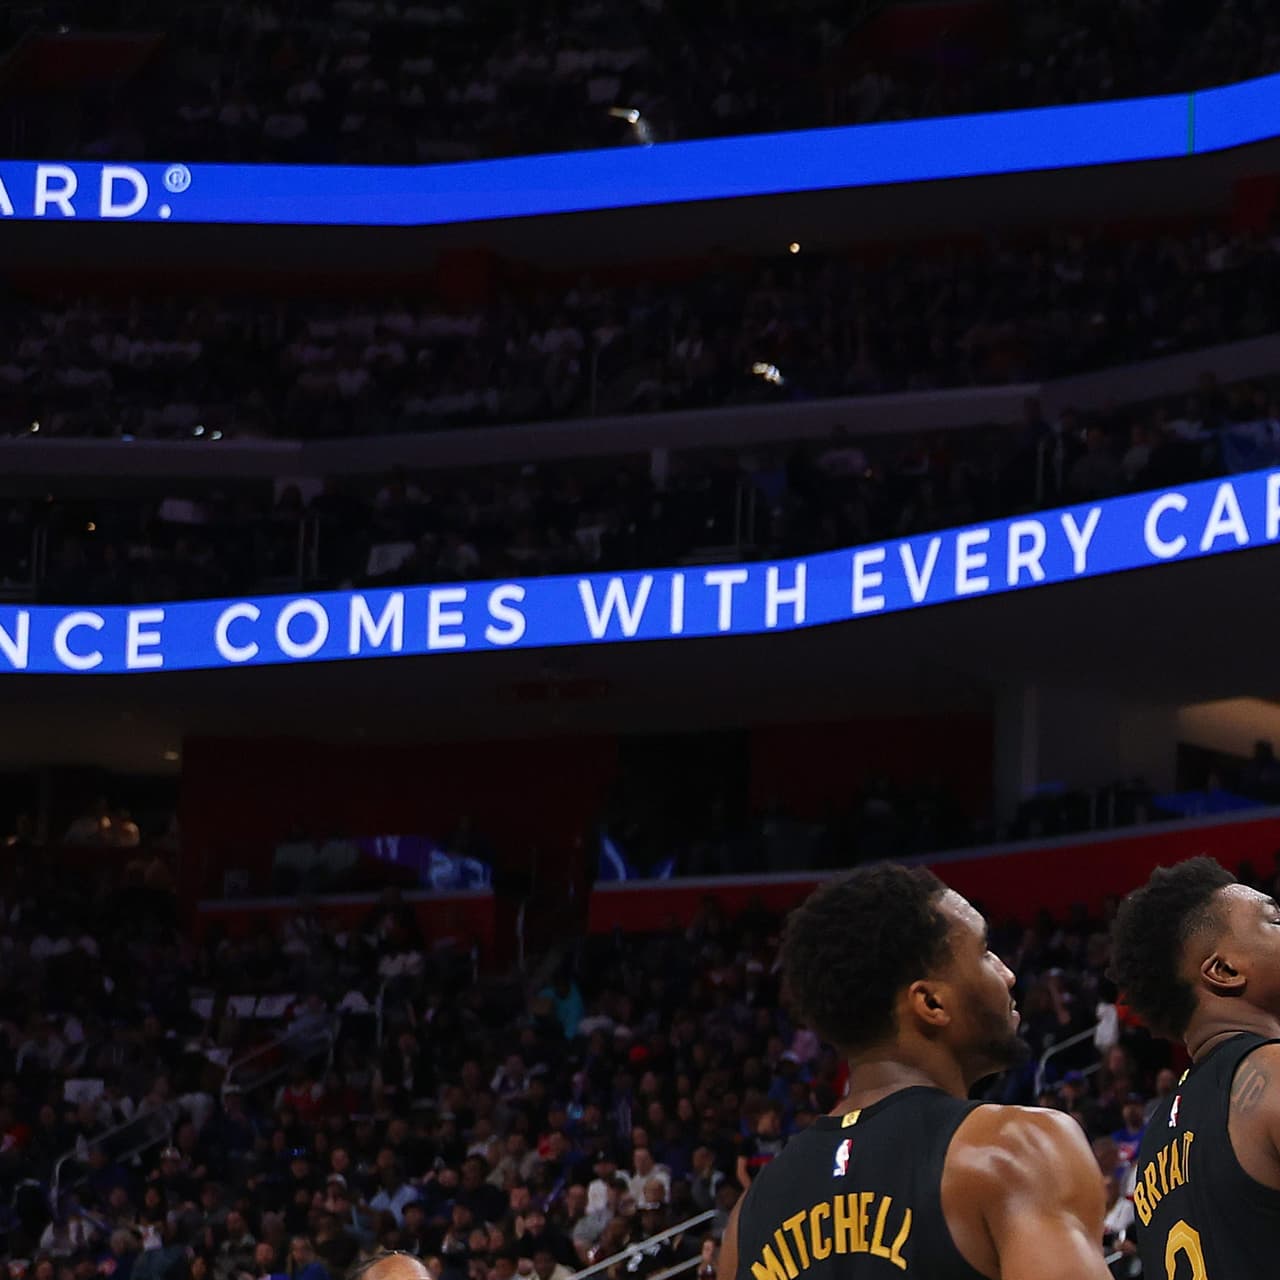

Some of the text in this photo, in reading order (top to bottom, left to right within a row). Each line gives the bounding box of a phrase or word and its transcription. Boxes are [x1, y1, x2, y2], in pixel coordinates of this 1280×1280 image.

[215, 585, 527, 663] COMES
[578, 564, 807, 640] WITH
[851, 508, 1101, 614] EVERY
